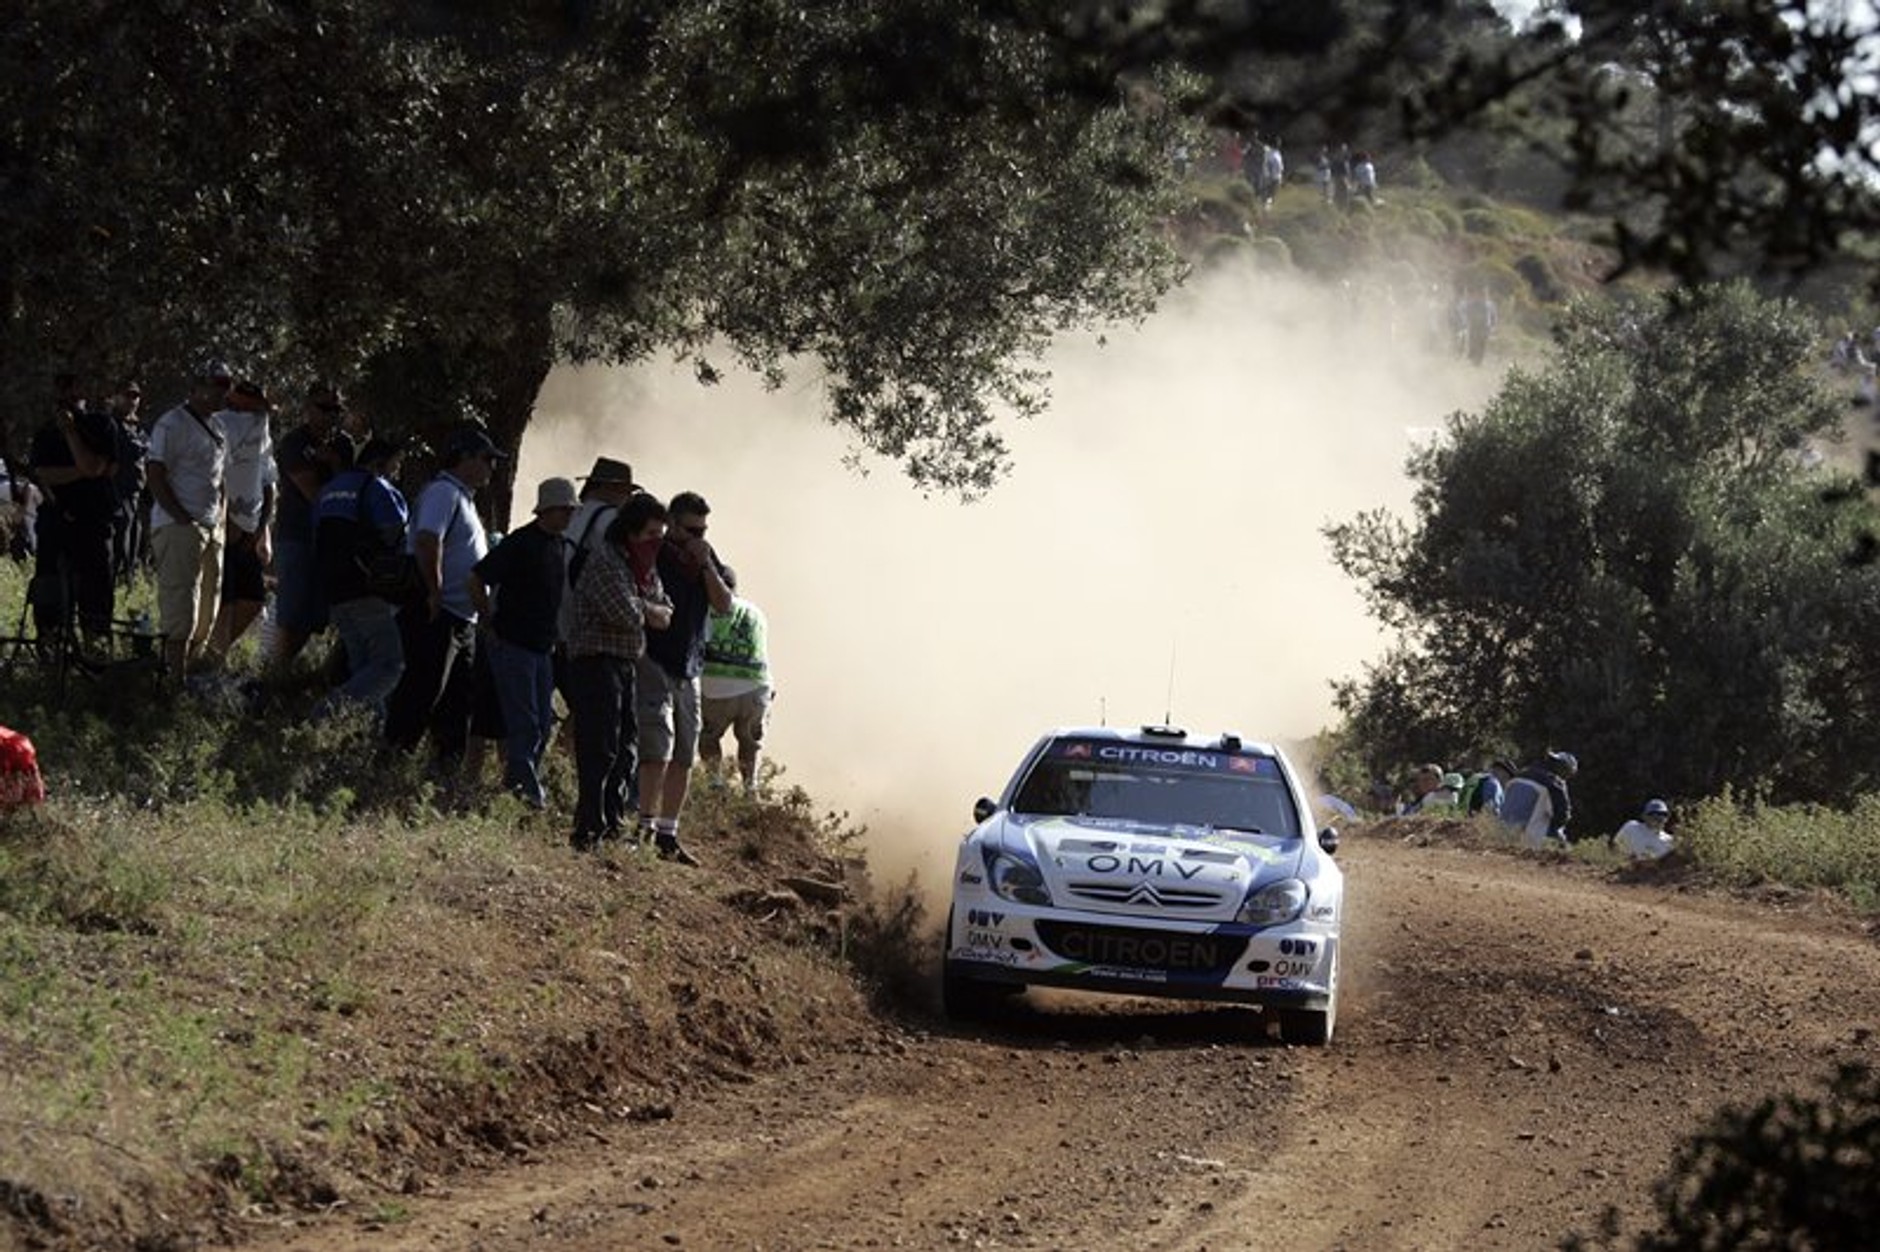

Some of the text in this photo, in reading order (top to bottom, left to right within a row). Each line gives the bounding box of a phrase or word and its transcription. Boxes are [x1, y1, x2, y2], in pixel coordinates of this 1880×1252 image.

[1100, 747, 1217, 767] CITROËN
[1088, 855, 1204, 879] OMV
[1280, 938, 1317, 955] OMV
[1275, 960, 1313, 976] OMV
